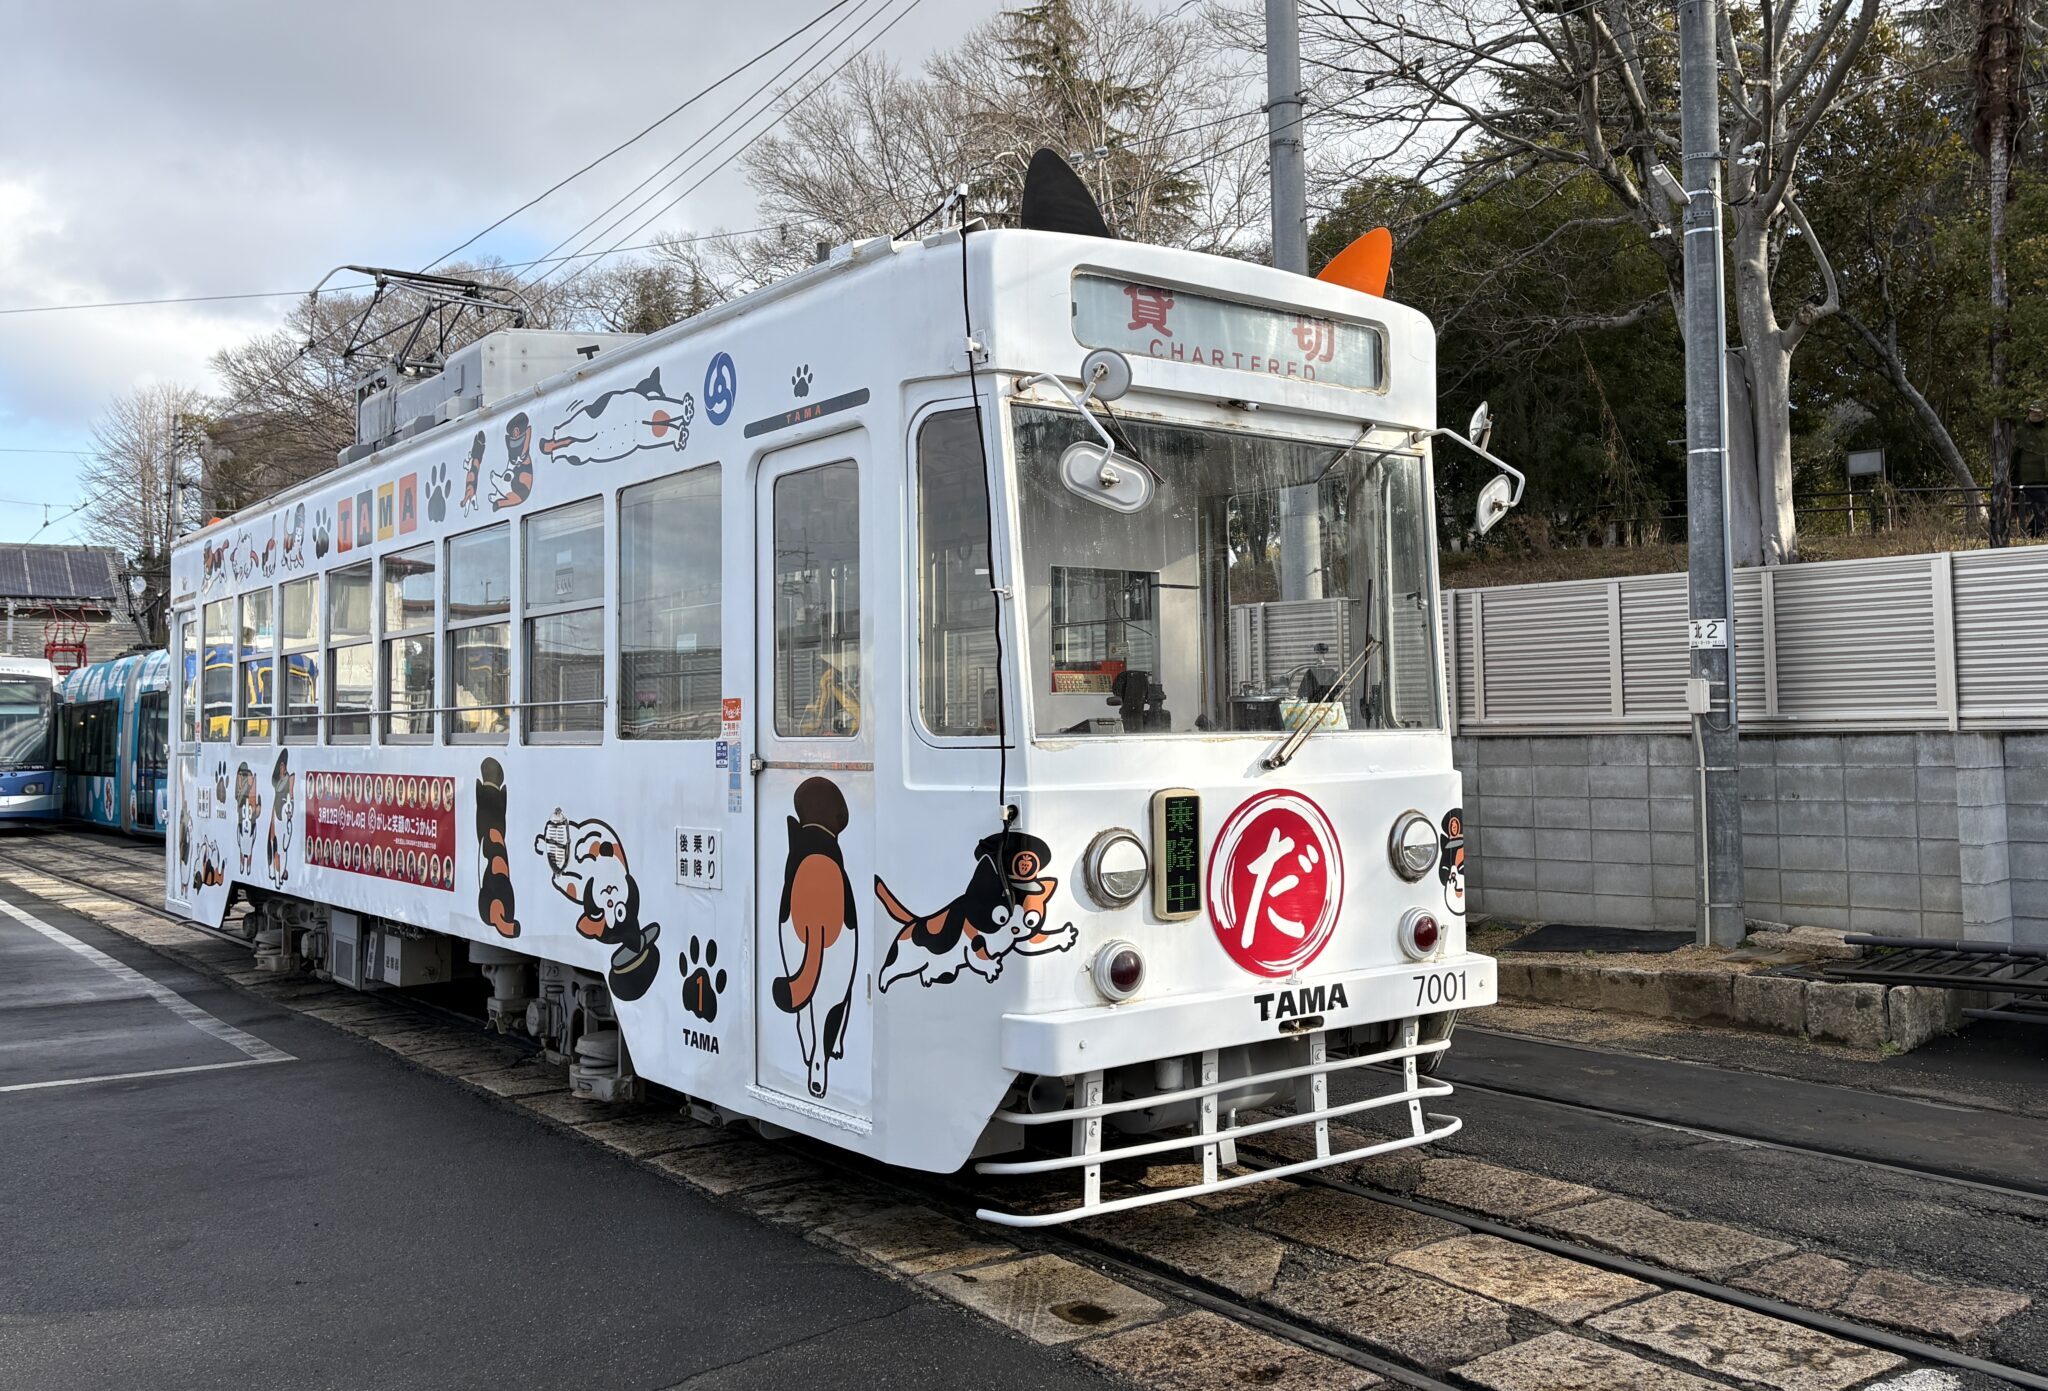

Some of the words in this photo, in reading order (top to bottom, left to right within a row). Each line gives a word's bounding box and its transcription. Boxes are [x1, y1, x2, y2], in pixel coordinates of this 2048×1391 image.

[1149, 339, 1316, 381] CHARTERED
[786, 404, 822, 424] TAMA
[340, 487, 414, 541] TAMA
[1706, 623, 1718, 639] 2
[679, 833, 716, 855] 後乗り
[1167, 798, 1196, 911] 乗降中
[679, 857, 716, 880] 前降り
[1240, 826, 1320, 949] だ
[696, 975, 704, 1012] 1
[1253, 982, 1350, 1022] TAMA
[1412, 970, 1466, 1007] 7001
[682, 1028, 720, 1054] TAMA
